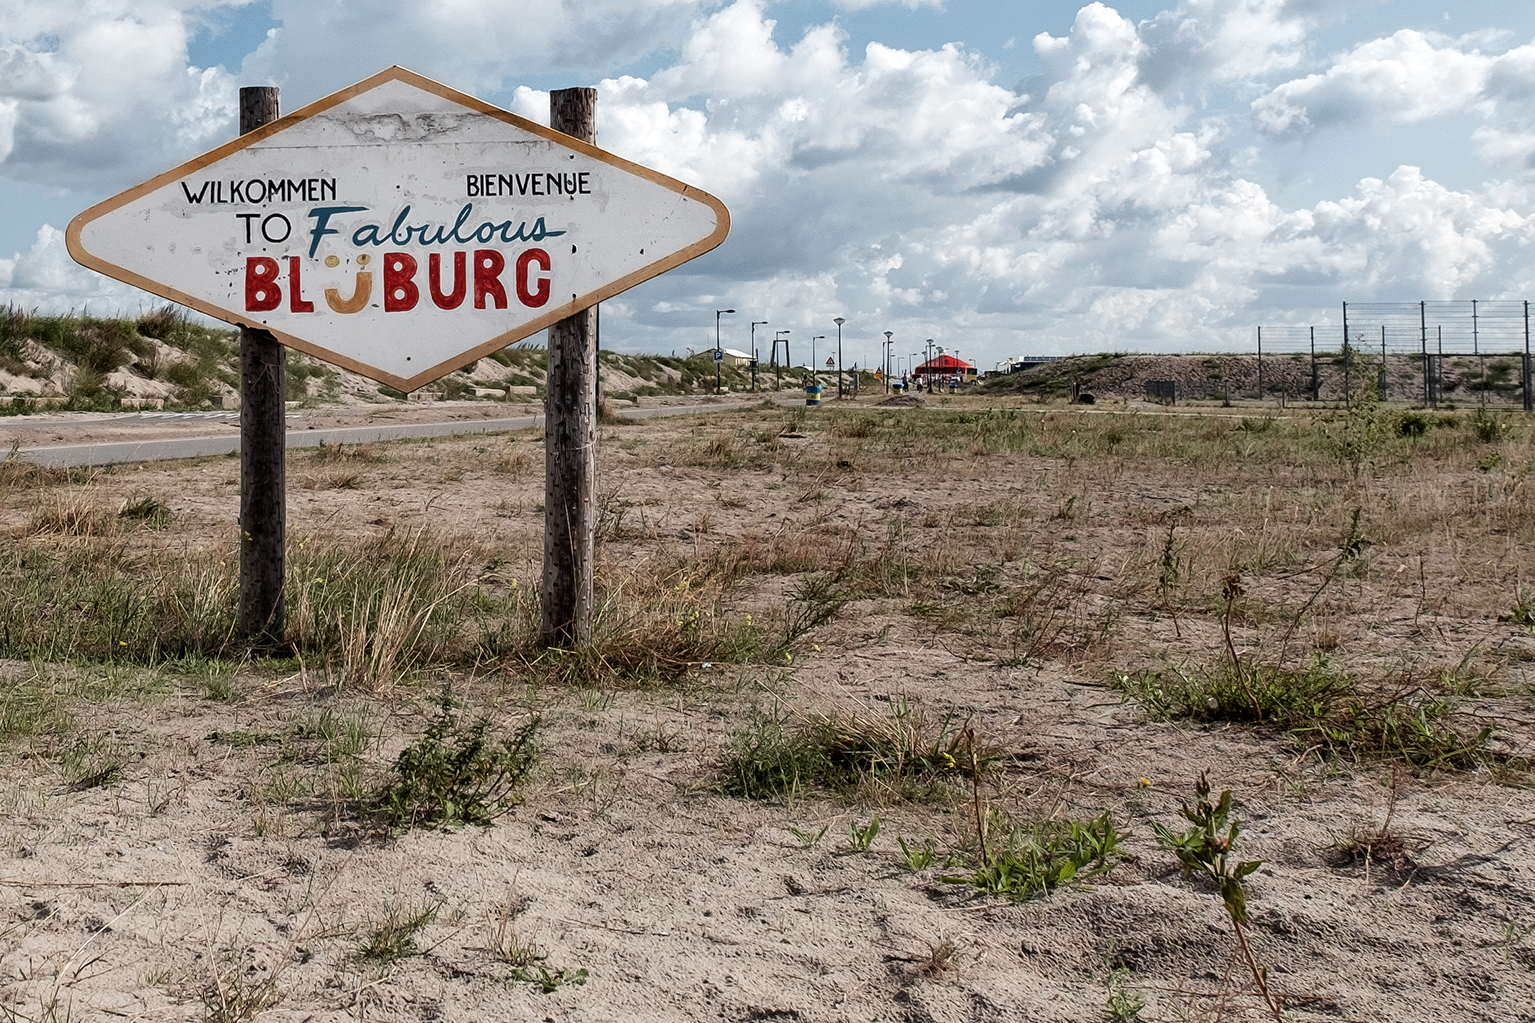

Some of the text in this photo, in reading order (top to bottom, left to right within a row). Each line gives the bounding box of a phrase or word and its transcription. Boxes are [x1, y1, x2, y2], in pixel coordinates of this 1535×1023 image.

[180, 171, 592, 205] WILKOMMEN BIENVENUE
[235, 202, 567, 259] TO Fabulous
